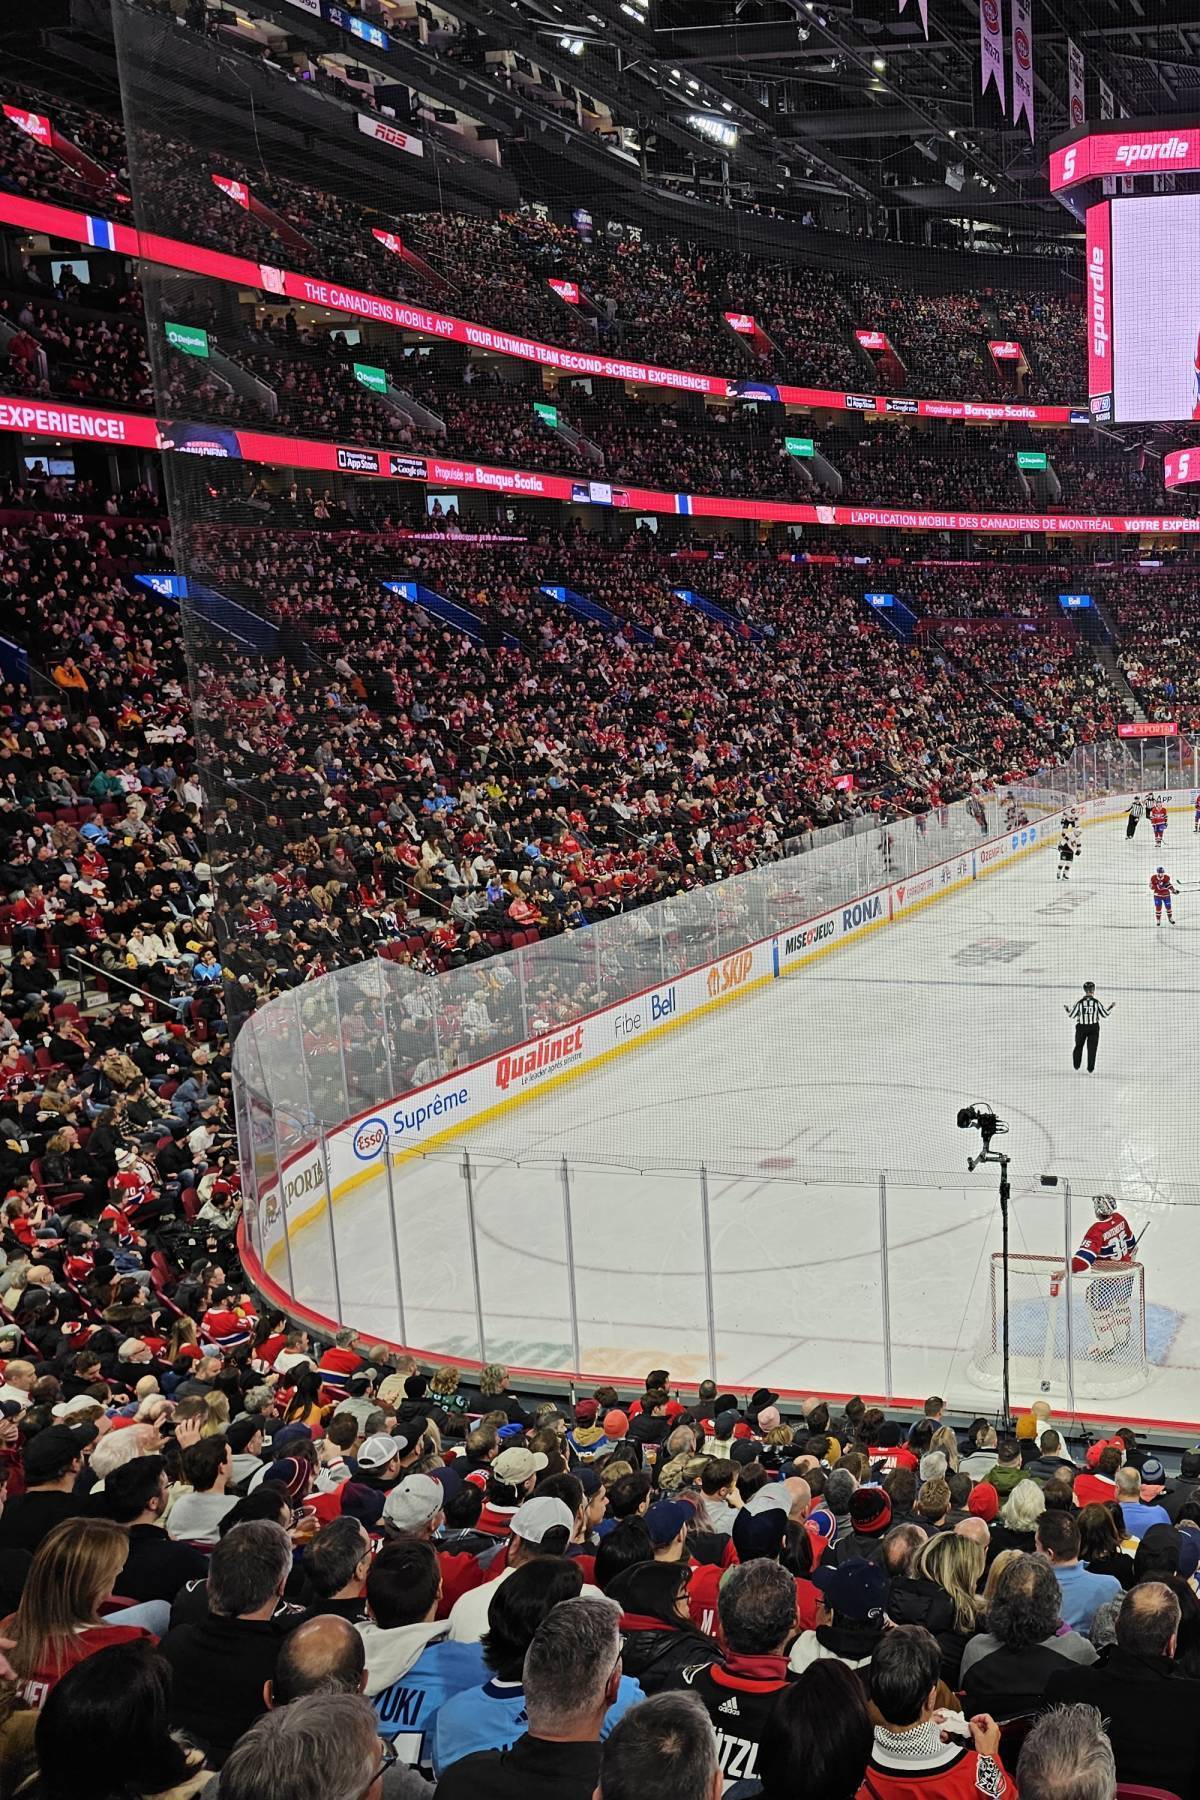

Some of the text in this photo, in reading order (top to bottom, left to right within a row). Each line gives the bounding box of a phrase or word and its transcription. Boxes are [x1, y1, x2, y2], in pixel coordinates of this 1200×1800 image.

[375, 124, 407, 147] RDS
[1063, 148, 1076, 180] S
[1116, 138, 1188, 166] spordle
[1090, 246, 1108, 358] spordle
[304, 282, 710, 390] THE CANADIENS MOBILE APP YOUR ULTIMATE TEAM SECOND-SCREEN EXPERIENCE!
[0, 404, 125, 440] EXPERIENCE!
[926, 404, 951, 416] Propulsée
[952, 406, 962, 416] par
[964, 404, 1003, 419] Banque
[348, 458, 378, 471] App Store
[398, 463, 427, 478] Google play
[435, 466, 464, 482] Propulsée
[465, 472, 474, 484] par
[476, 468, 513, 490] Banque
[1178, 454, 1190, 480] S
[851, 512, 917, 526] L'APPLICATION
[918, 515, 956, 528] MOBILE
[959, 517, 978, 528] DES
[980, 518, 1040, 530] CANADIENS
[1042, 519, 1057, 530] DE
[1059, 517, 1114, 530] MONTRÉAL
[1124, 520, 1160, 530] VOTRE
[872, 596, 884, 605] Bell
[1068, 597, 1081, 605] Bell
[842, 896, 882, 932] RONA
[721, 950, 753, 990] SKIP
[652, 987, 676, 1022] Bell
[1083, 1006, 1093, 1015] 70
[614, 1013, 641, 1038] Fibe
[496, 1025, 584, 1090] Qualinet
[521, 1051, 582, 1086] Le leader après sinistre
[394, 1088, 468, 1133] Suprême
[374, 1686, 425, 1726] UKI
[718, 1705, 740, 1716] adidas
